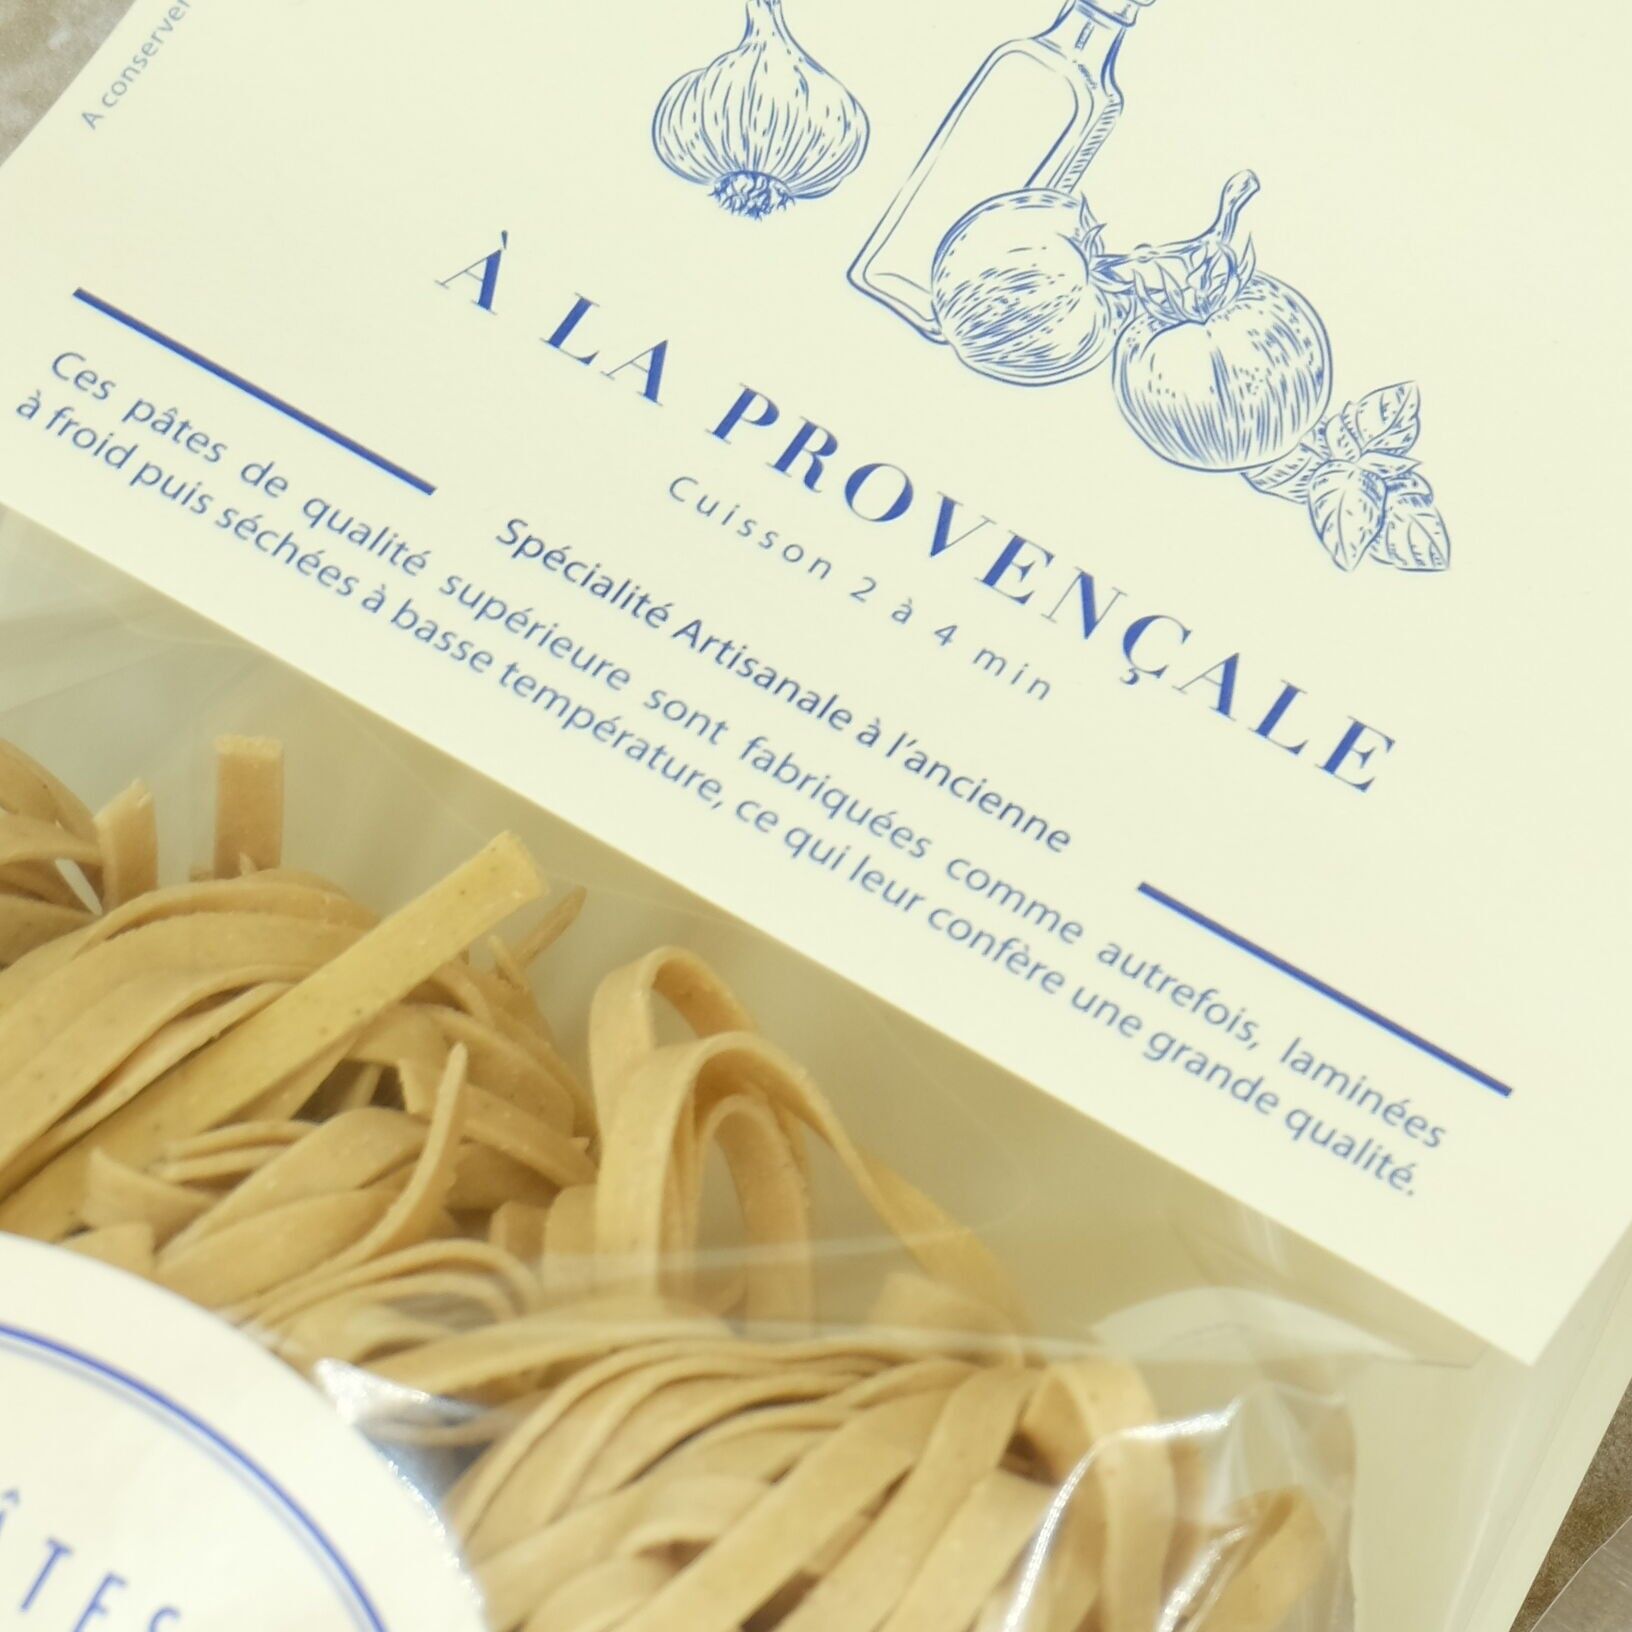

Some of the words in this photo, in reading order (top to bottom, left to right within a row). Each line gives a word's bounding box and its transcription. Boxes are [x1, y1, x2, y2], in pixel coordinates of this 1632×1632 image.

[15, 389, 42, 421] à
[44, 405, 139, 471] froid
[128, 461, 214, 515] puis
[214, 507, 360, 598] séchées
[360, 583, 387, 614] à
[389, 597, 495, 674] basse
[498, 661, 724, 810] température,
[734, 800, 780, 834] ce
[783, 826, 852, 872] qui
[848, 854, 926, 913] leur
[927, 907, 1066, 995] confère
[1070, 986, 1144, 1039] une
[1142, 1031, 1281, 1116] grande
[1283, 1107, 1417, 1197] qualité.
[51, 351, 117, 401] Ces
[120, 398, 228, 464] pâtes
[239, 460, 289, 499] de
[302, 497, 432, 577] qualité
[438, 575, 631, 691] supérieure
[642, 689, 729, 746] sont
[738, 735, 933, 859] fabriquées
[945, 857, 1084, 945] comme
[1096, 942, 1259, 1051] autrefois,
[1279, 1036, 1446, 1149] laminées
[434, 229, 509, 315] À
[543, 293, 669, 405] LA
[705, 383, 1396, 794] PROVENÇALE
[495, 517, 675, 630] Spécialité
[670, 618, 854, 732] Artisanale
[855, 717, 882, 749] à
[668, 476, 832, 580] Cuisson
[848, 575, 878, 604] 2
[889, 596, 914, 626] à
[932, 623, 959, 648] 4
[971, 647, 1052, 702] min
